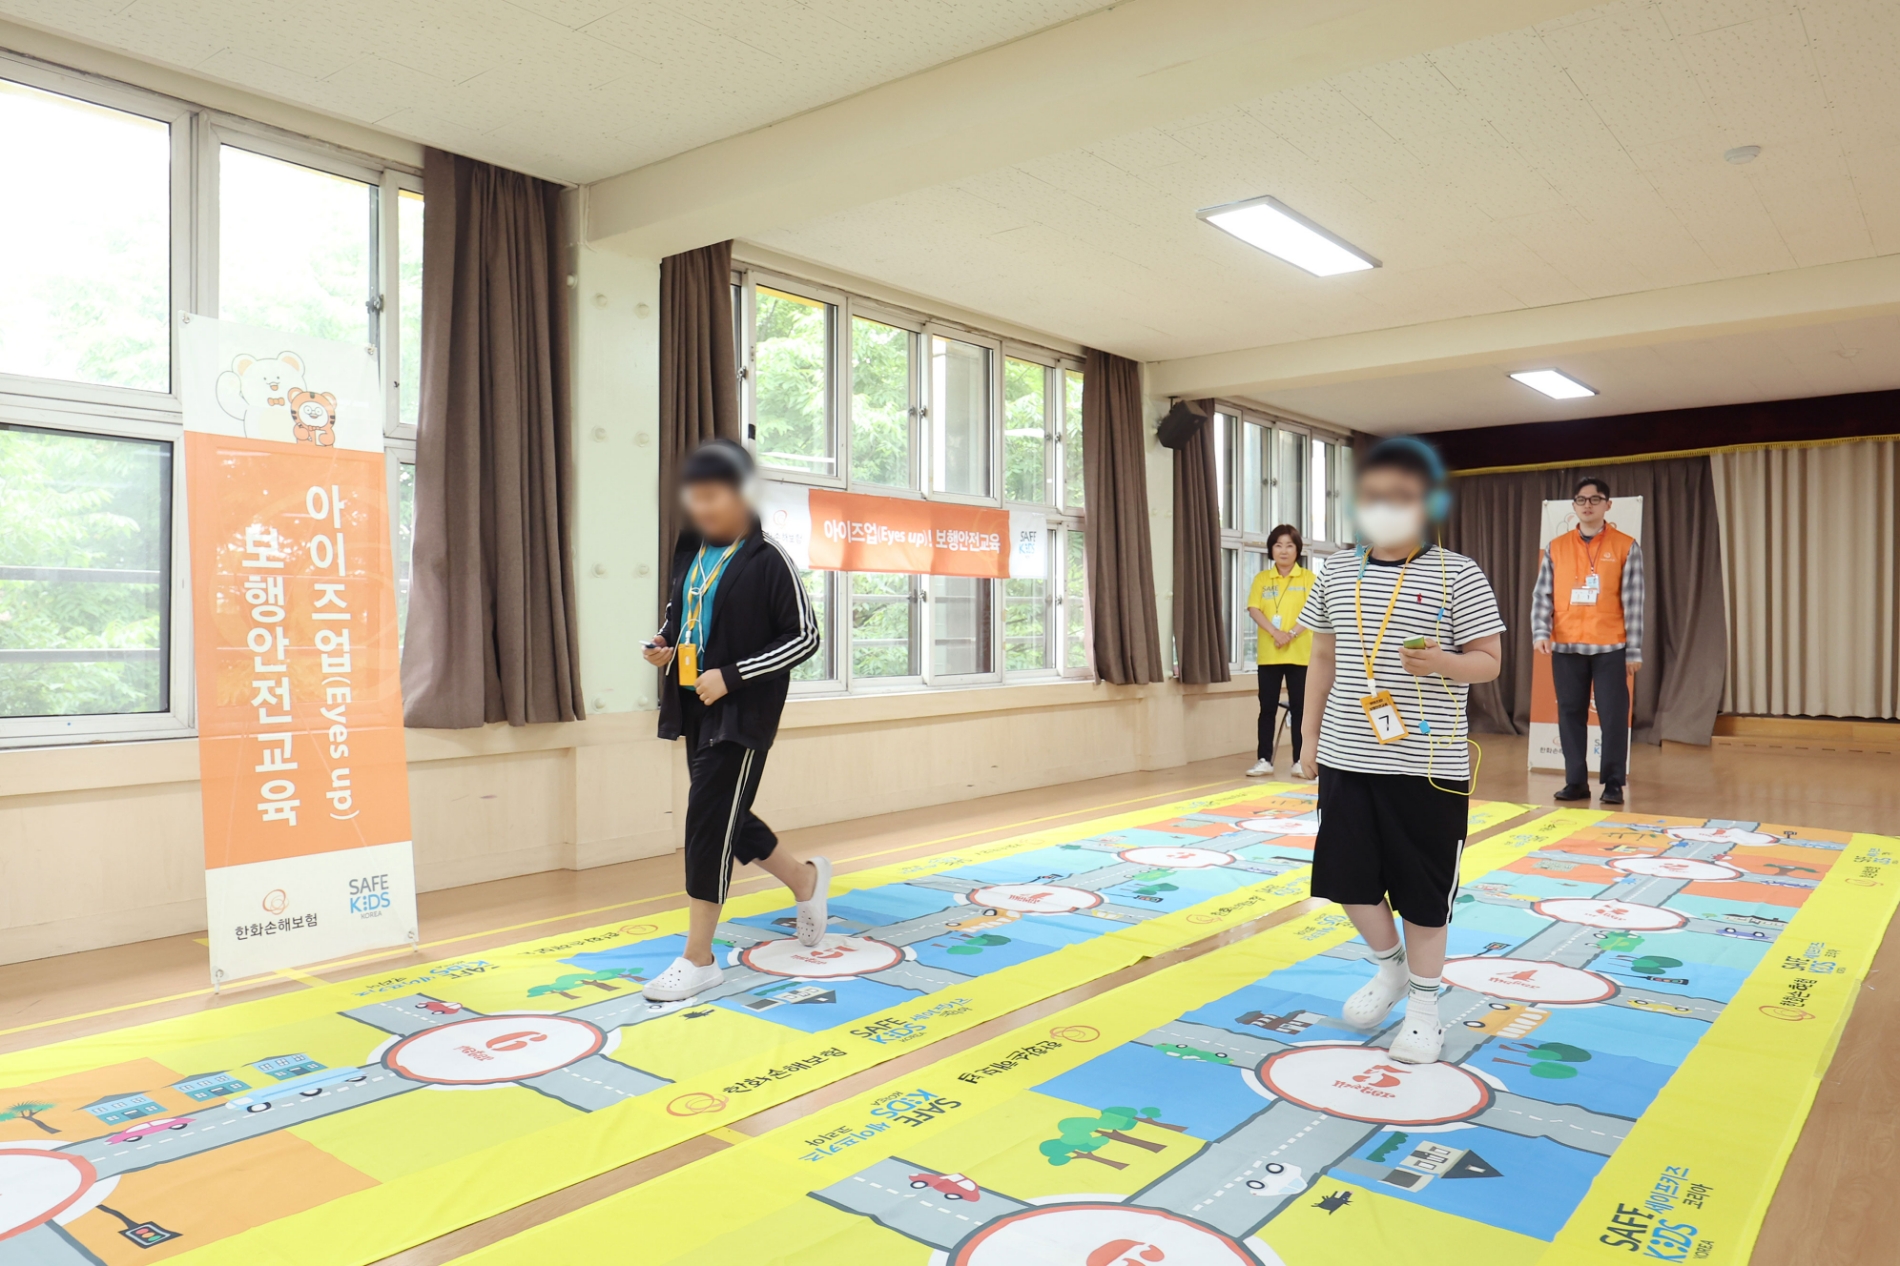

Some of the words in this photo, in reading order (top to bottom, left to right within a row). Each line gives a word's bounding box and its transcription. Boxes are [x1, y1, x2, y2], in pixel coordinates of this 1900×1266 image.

[823, 518, 906, 547] 아이즈업(Eyes
[907, 529, 933, 548] up)!
[935, 528, 1001, 555] 보행안전교육
[305, 483, 352, 760] 아이즈업(Eyes
[241, 526, 300, 829] 보행안전교육
[325, 767, 360, 821] up)
[348, 872, 390, 896] SAFE
[234, 912, 319, 941] 한화손해보험
[360, 910, 383, 920] KOREA
[485, 1030, 548, 1052] 6
[849, 1017, 908, 1039] SAFE
[722, 1046, 848, 1094] 한화손해보험
[1352, 1064, 1412, 1088] 5
[892, 1097, 963, 1128] SAFE
[797, 1121, 892, 1163] 세이프키즈
[1643, 1165, 1690, 1215] 세이프키즈
[1682, 1183, 1715, 1210] 코리아
[1599, 1202, 1655, 1252] SAFE
